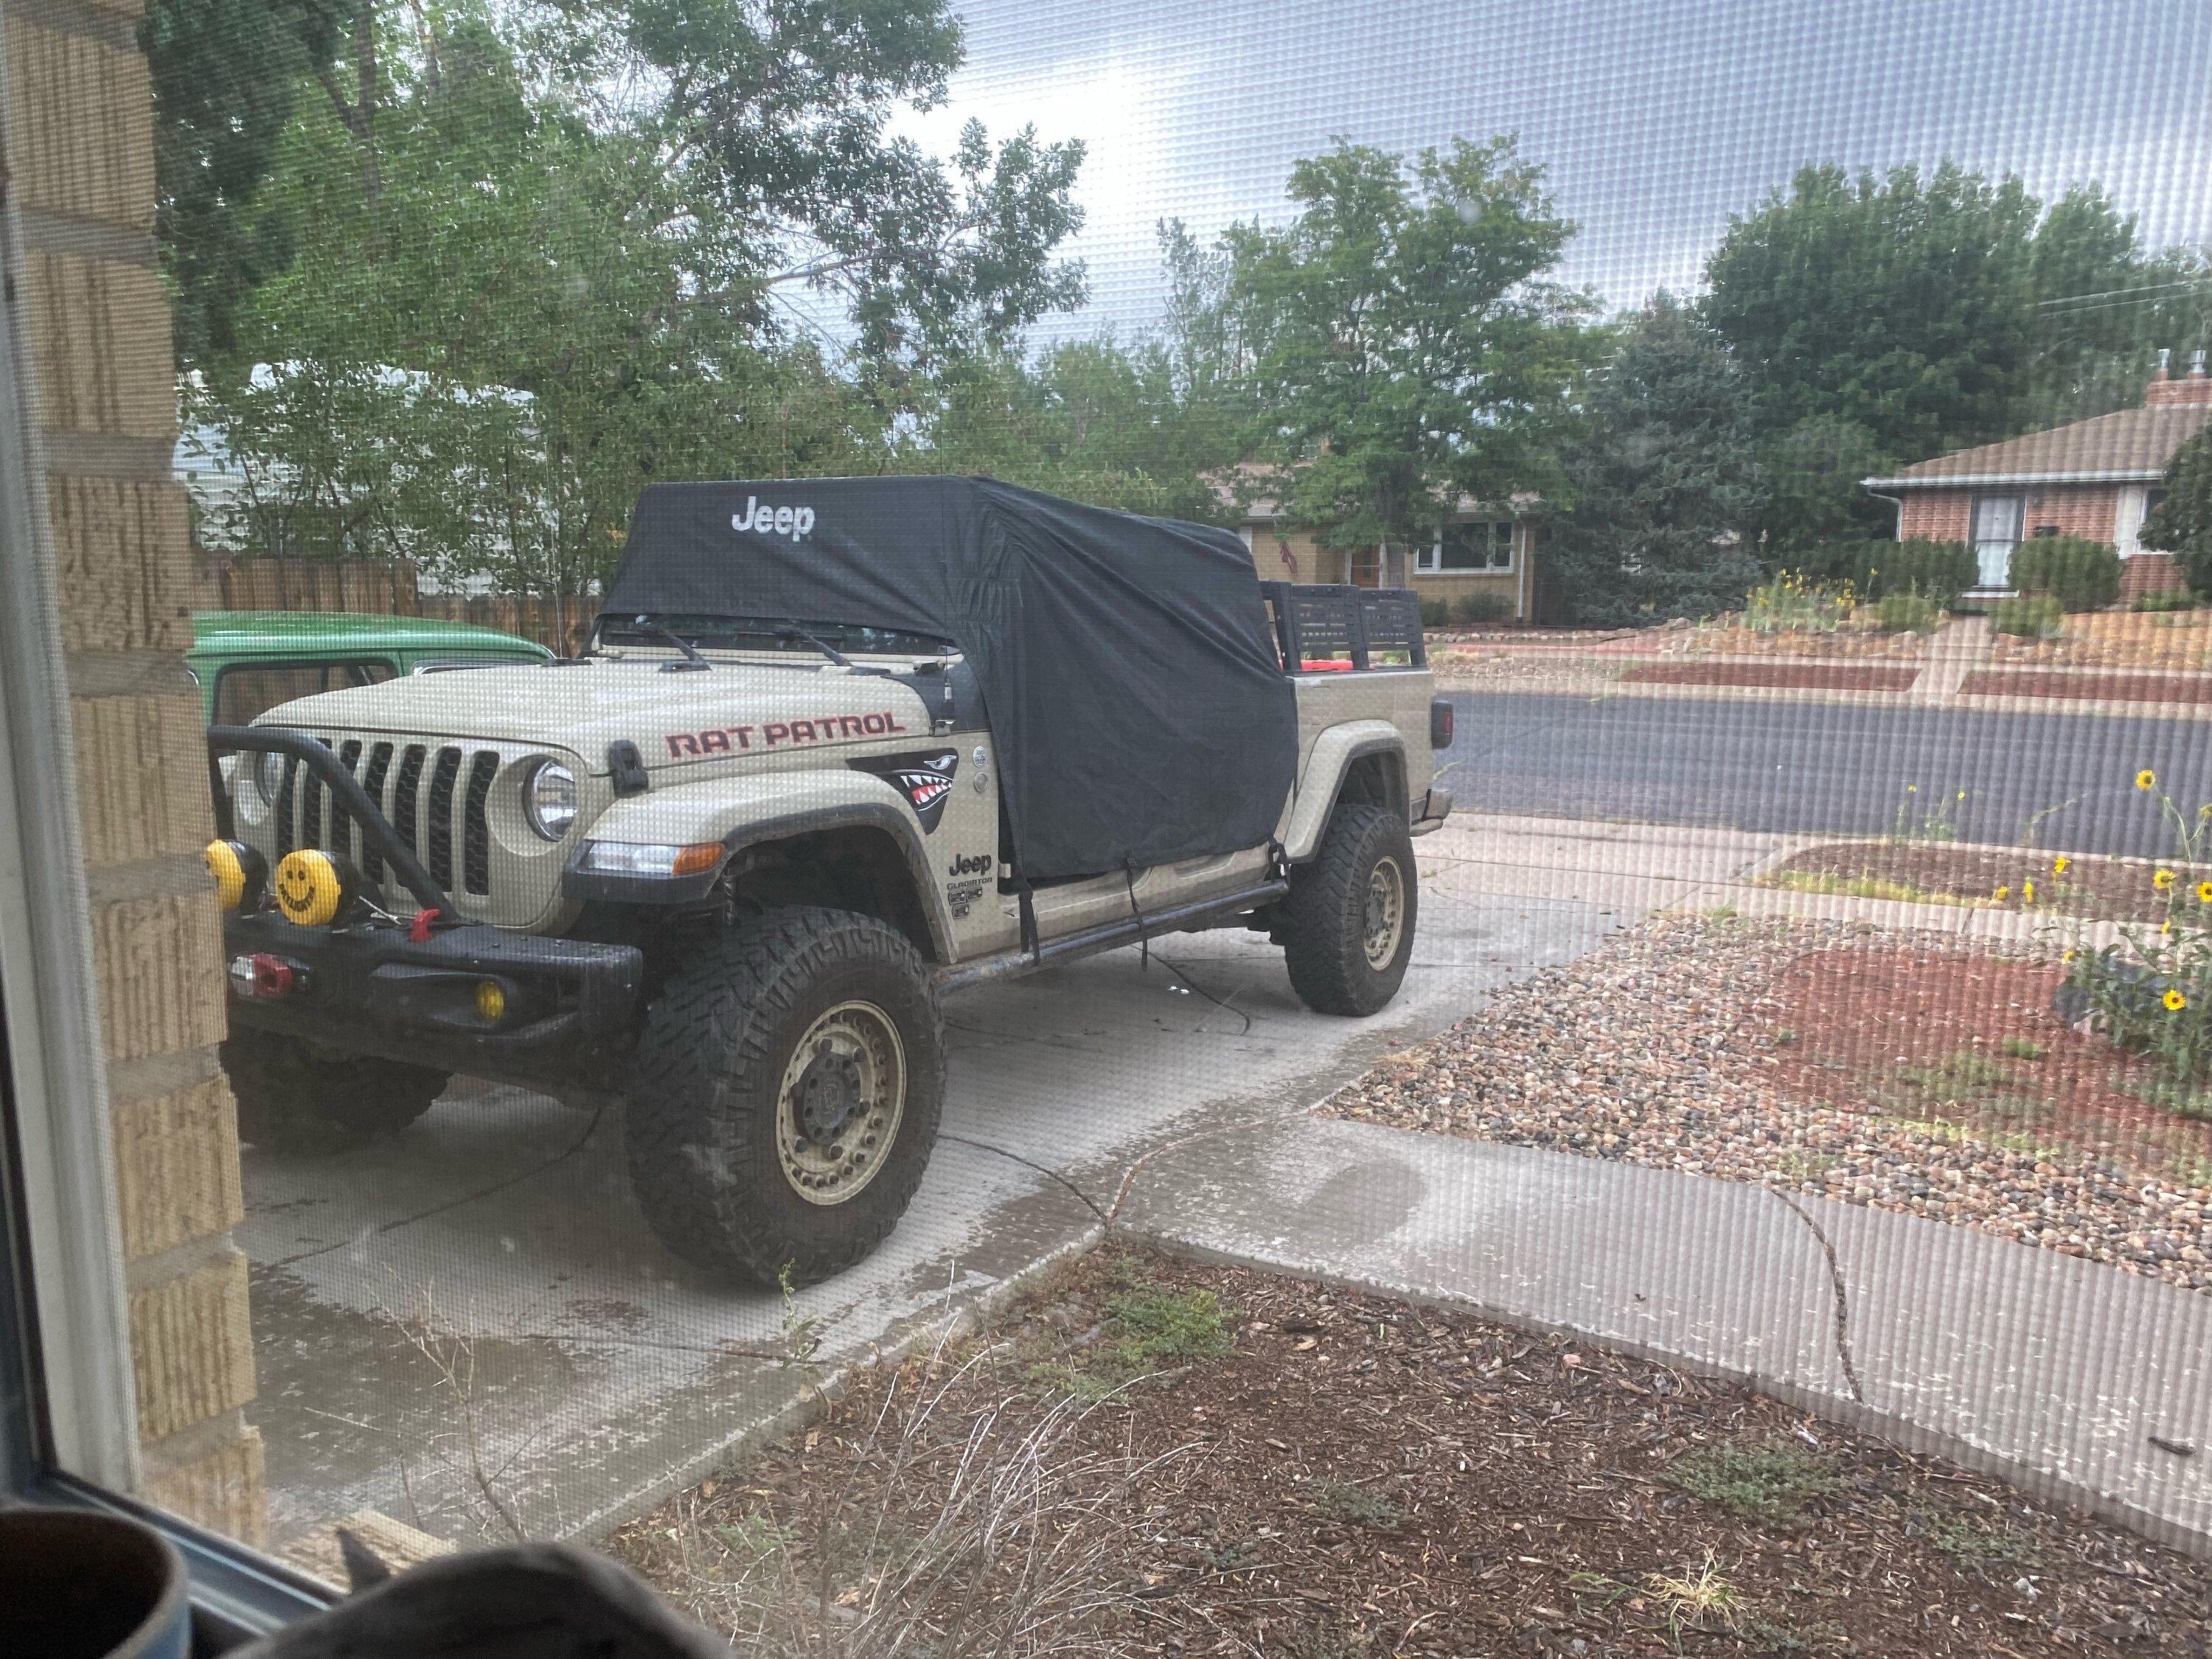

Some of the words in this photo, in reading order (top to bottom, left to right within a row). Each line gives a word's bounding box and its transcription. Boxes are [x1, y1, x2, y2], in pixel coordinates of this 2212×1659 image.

[731, 495, 815, 542] Jeep
[665, 726, 754, 759] RAT
[762, 712, 905, 745] PATROL
[949, 853, 992, 876] Jeep
